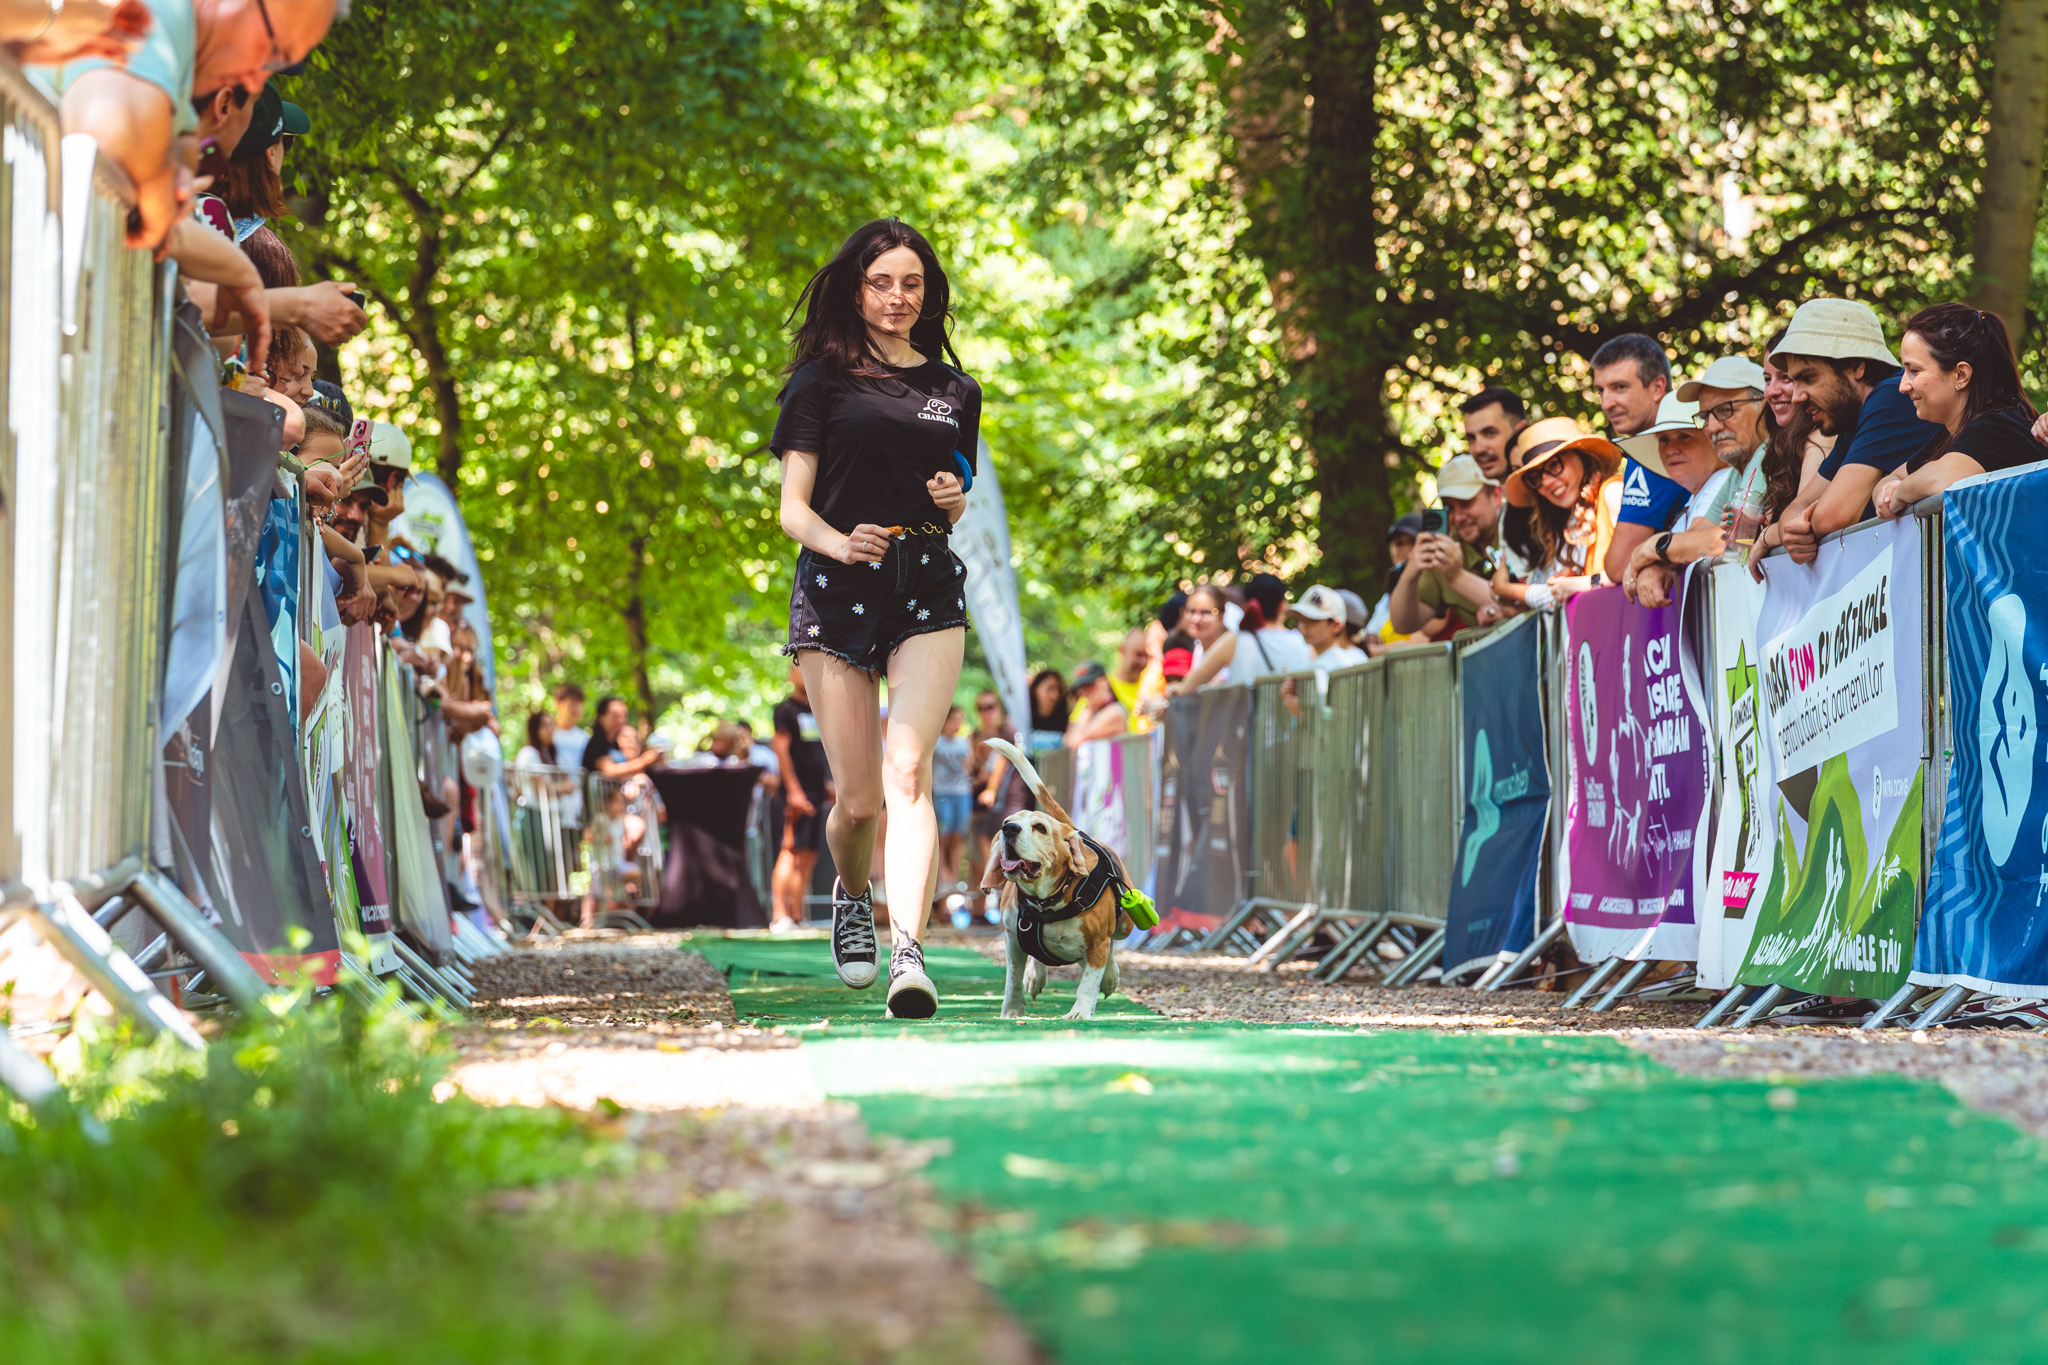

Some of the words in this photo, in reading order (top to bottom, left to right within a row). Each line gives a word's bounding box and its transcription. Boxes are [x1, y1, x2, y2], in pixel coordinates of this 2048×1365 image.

[1788, 641, 1815, 696] FUN
[1818, 630, 1833, 679] CU
[1834, 574, 1888, 668] OBSTACOLE
[1778, 715, 1806, 770] pentru
[1866, 656, 1884, 699] lor
[1878, 927, 1902, 975] TĂU
